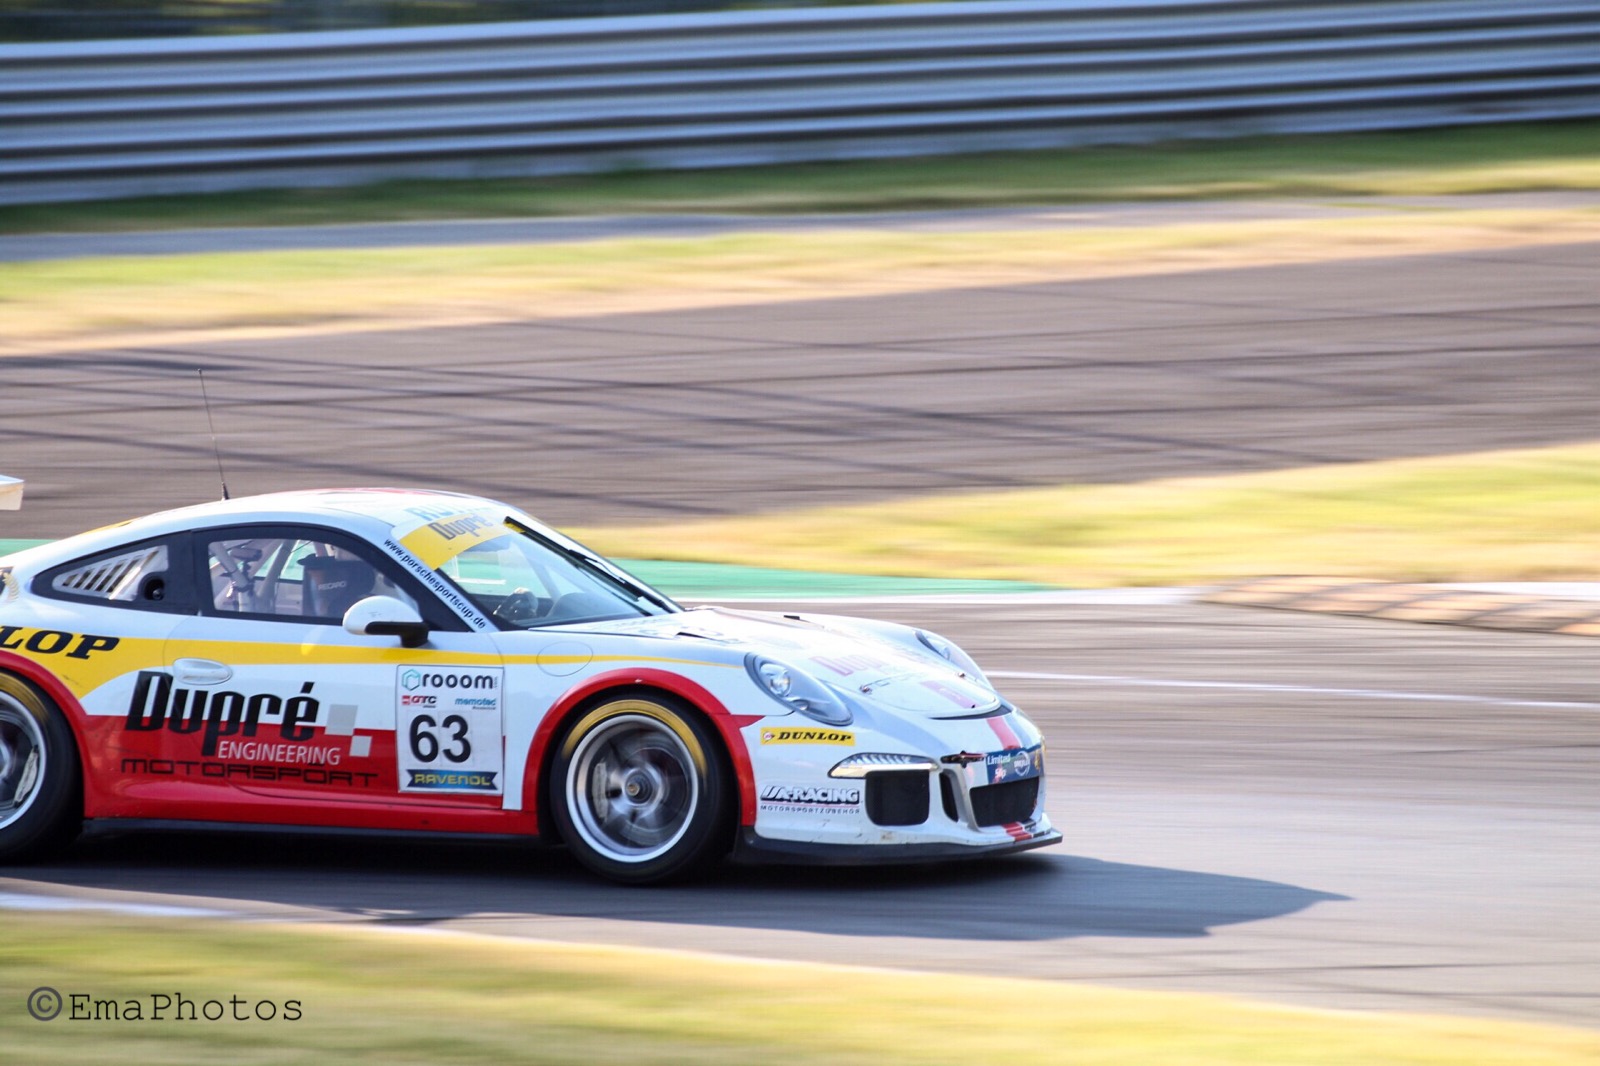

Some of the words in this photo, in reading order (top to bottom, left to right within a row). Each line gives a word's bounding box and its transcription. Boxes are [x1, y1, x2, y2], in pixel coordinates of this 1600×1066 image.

[383, 538, 487, 629] www.porschesportscup.de
[422, 674, 493, 689] rooom
[126, 670, 320, 756] Dupré
[409, 714, 471, 763] 63
[778, 731, 852, 742] DUNLOP
[217, 740, 341, 766] ENGINEERING
[121, 758, 379, 787] MOTORSPORT
[415, 774, 491, 786] RAVENOL
